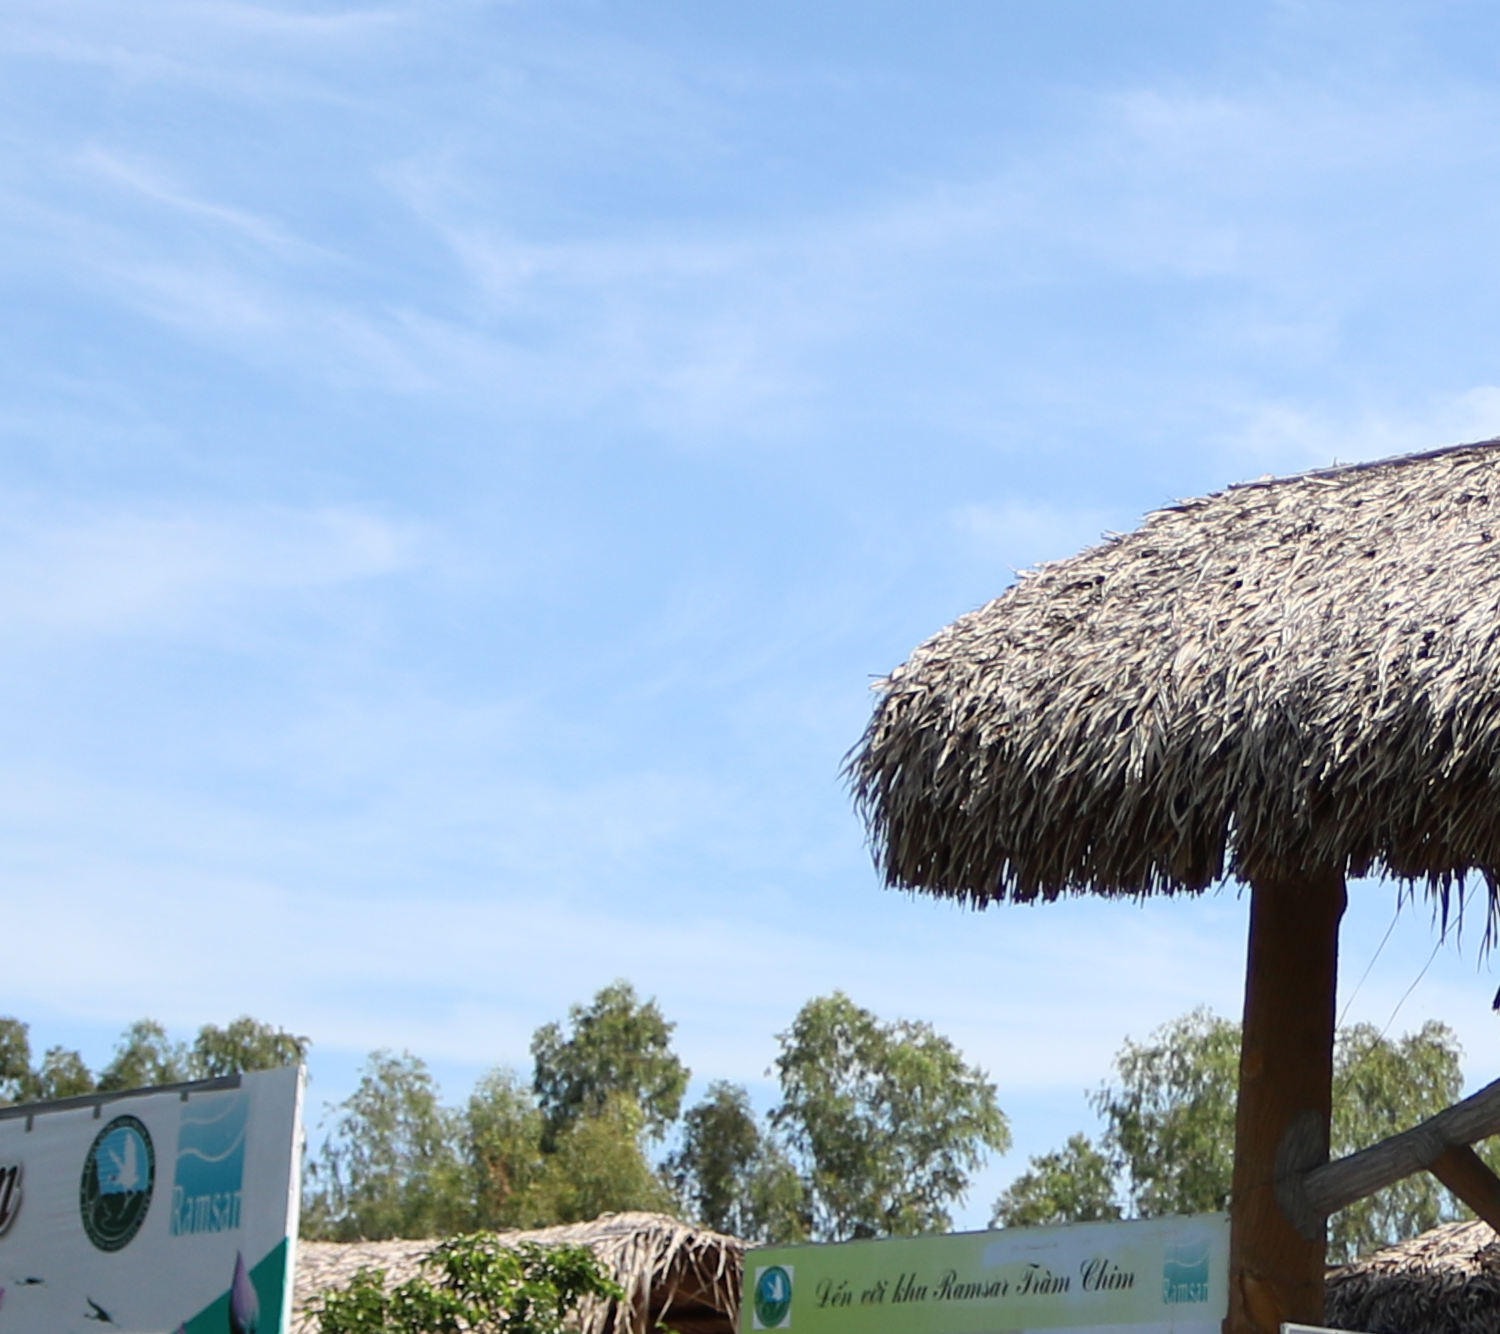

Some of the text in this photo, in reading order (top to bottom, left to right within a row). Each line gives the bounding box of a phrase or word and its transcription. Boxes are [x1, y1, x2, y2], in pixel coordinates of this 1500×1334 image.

[169, 1185, 243, 1237] Ramsar
[893, 1272, 927, 1306] khu
[934, 1269, 1010, 1303] Ramsar
[1079, 1256, 1136, 1293] Chim
[1163, 1278, 1210, 1305] Ramsar
